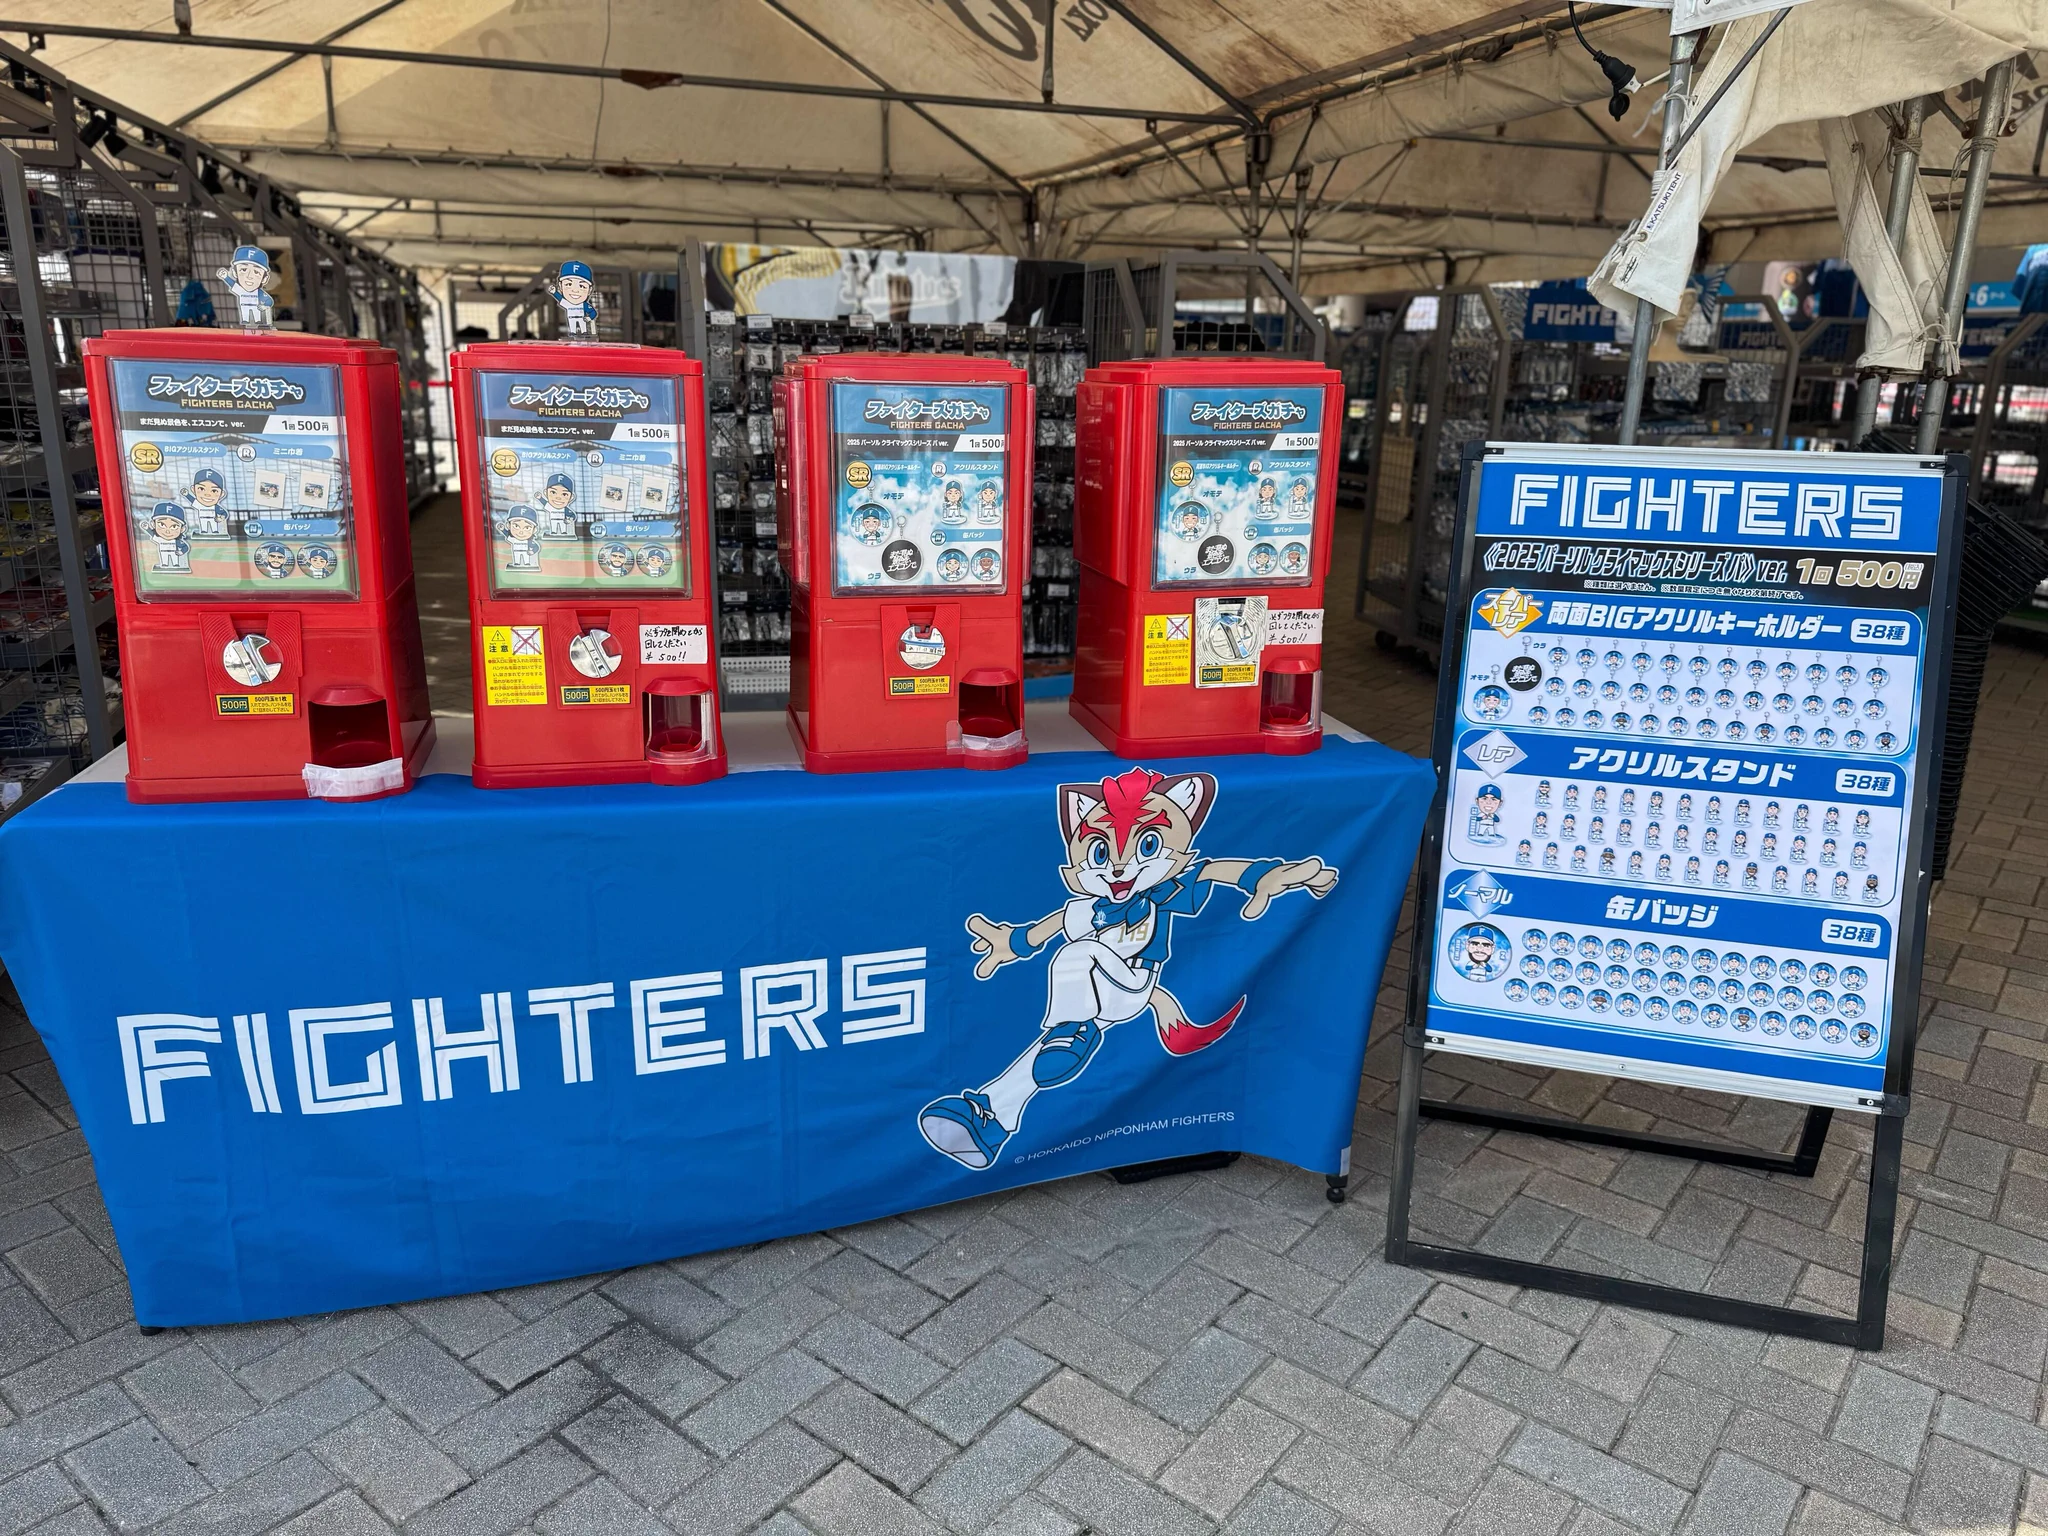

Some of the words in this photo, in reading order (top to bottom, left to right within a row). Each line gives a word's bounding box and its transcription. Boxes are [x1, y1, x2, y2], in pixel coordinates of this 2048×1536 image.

[1650, 191, 1672, 225] KATSUKI
[1668, 172, 1682, 192] TENT
[149, 376, 303, 400] ファイターズガチャ
[510, 386, 649, 409] ファイターズガチャ
[181, 399, 233, 408] FIGHTERS
[237, 400, 275, 410] GACHA
[538, 407, 585, 416] FIGHTERS
[588, 409, 622, 418] GACHA
[866, 400, 989, 420] ファイターズガチャ
[1192, 401, 1305, 420] ファイターズガチャ
[890, 421, 932, 429] FIGHTERS
[1254, 421, 1282, 429] GACHA
[134, 449, 161, 466] SR
[494, 455, 517, 470] SR
[848, 468, 869, 482] SR
[1172, 468, 1191, 481] SR
[1202, 490, 1222, 498] オモテ
[1510, 474, 1904, 541] FIGHTERS
[283, 523, 310, 531] 缶バッジ
[867, 572, 881, 580] ウラ
[1756, 559, 1788, 583] ver.
[1796, 558, 1834, 585] 1回
[1836, 560, 1922, 589] 500円
[1482, 592, 1545, 611] スーパー
[1492, 608, 1528, 629] レア
[1547, 600, 1843, 640] 両面BIGアクリルキーホルダー
[1856, 624, 1906, 641] 38種
[894, 682, 914, 690] 500円
[222, 701, 248, 710] 500円
[566, 692, 589, 700] 500円
[1476, 745, 1517, 762] レア
[1568, 746, 1796, 788] アクリルスタンド
[1841, 773, 1891, 793] 38種
[1447, 884, 1514, 904] ノーマル
[1605, 895, 1719, 928] 缶バッジ
[1826, 923, 1876, 943] 38種
[116, 947, 927, 1126] FIGHTERS
[1027, 1136, 1092, 1162] HOKKAIDO
[1094, 1119, 1168, 1142] NIPPONHAM
[1172, 1111, 1235, 1127] FIGHTERS
